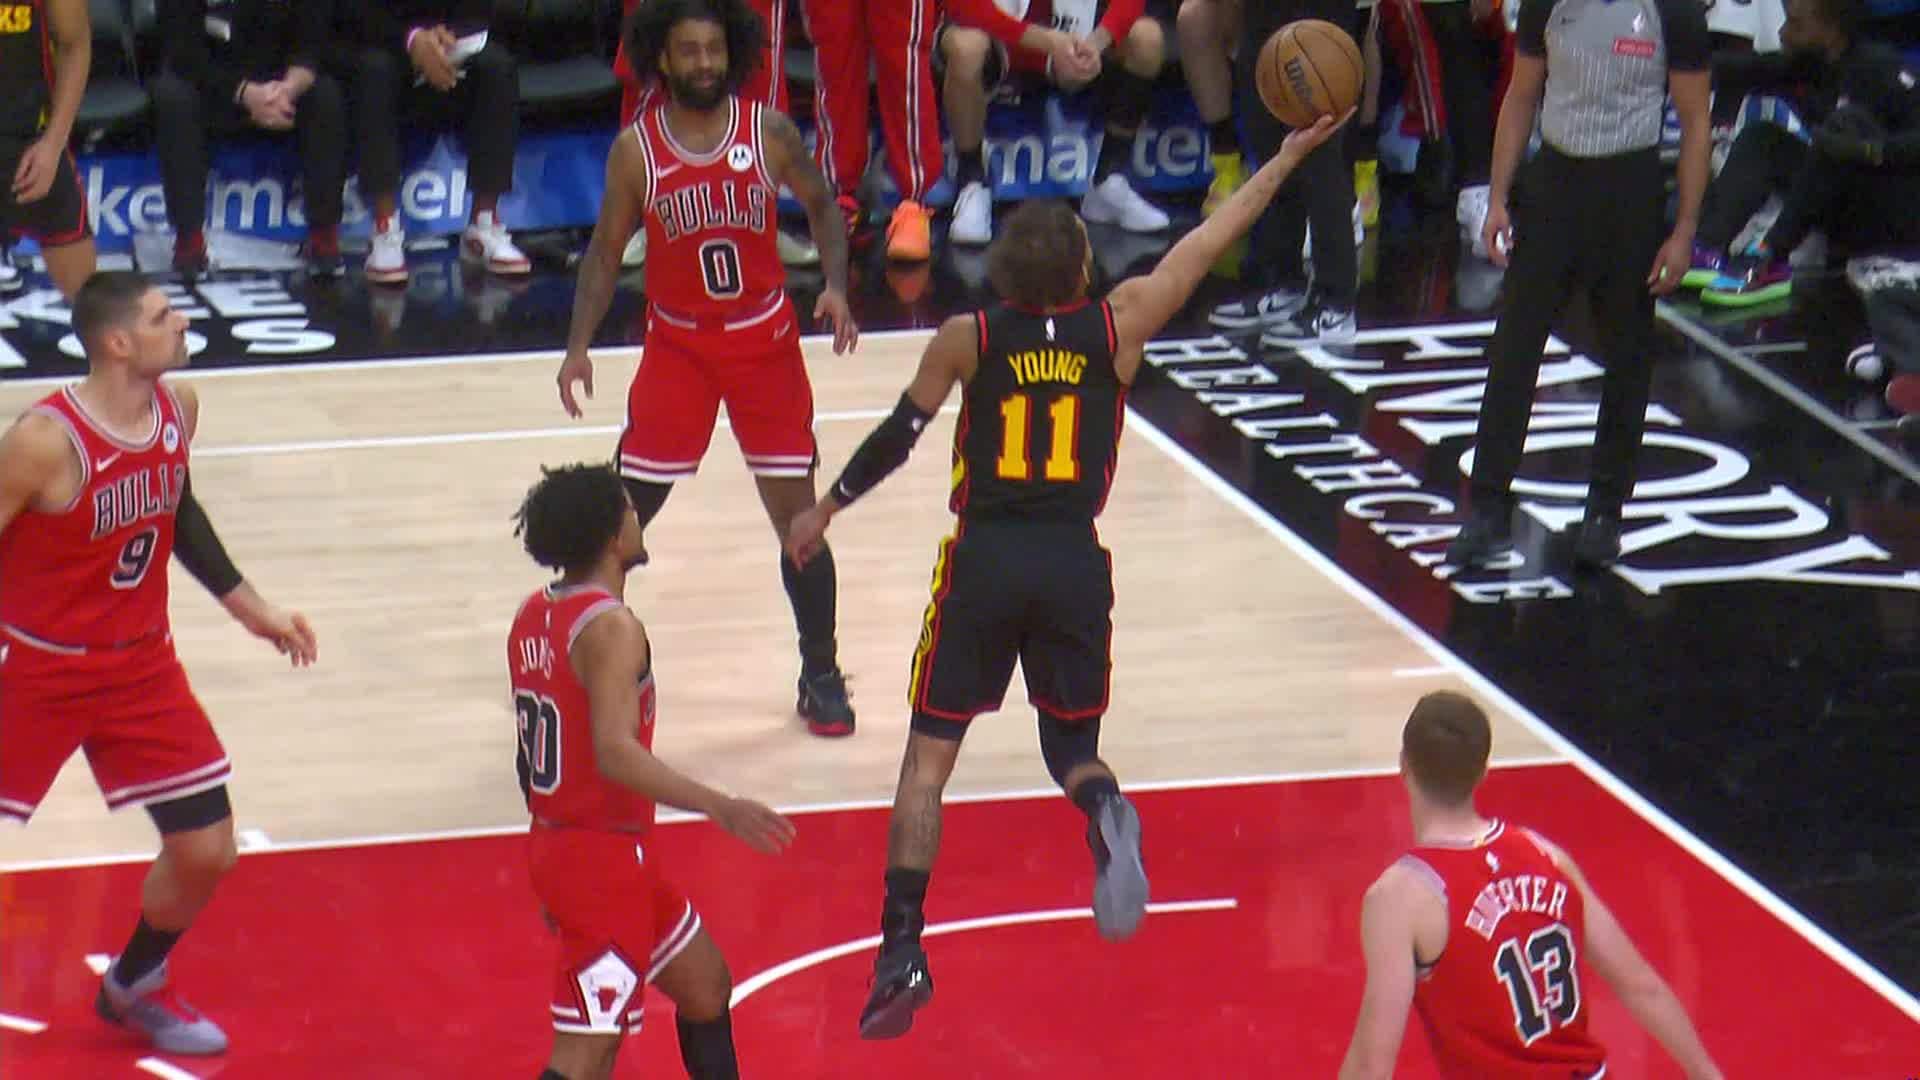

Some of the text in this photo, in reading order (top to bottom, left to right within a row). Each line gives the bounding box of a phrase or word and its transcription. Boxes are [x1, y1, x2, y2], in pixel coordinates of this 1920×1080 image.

[655, 180, 767, 242] BULLS
[699, 239, 743, 300] 0
[1008, 349, 1088, 385] YOUNG
[997, 394, 1081, 482] 11
[110, 526, 159, 590] 9
[519, 636, 556, 681] JONS
[1493, 922, 1581, 1048] 13
